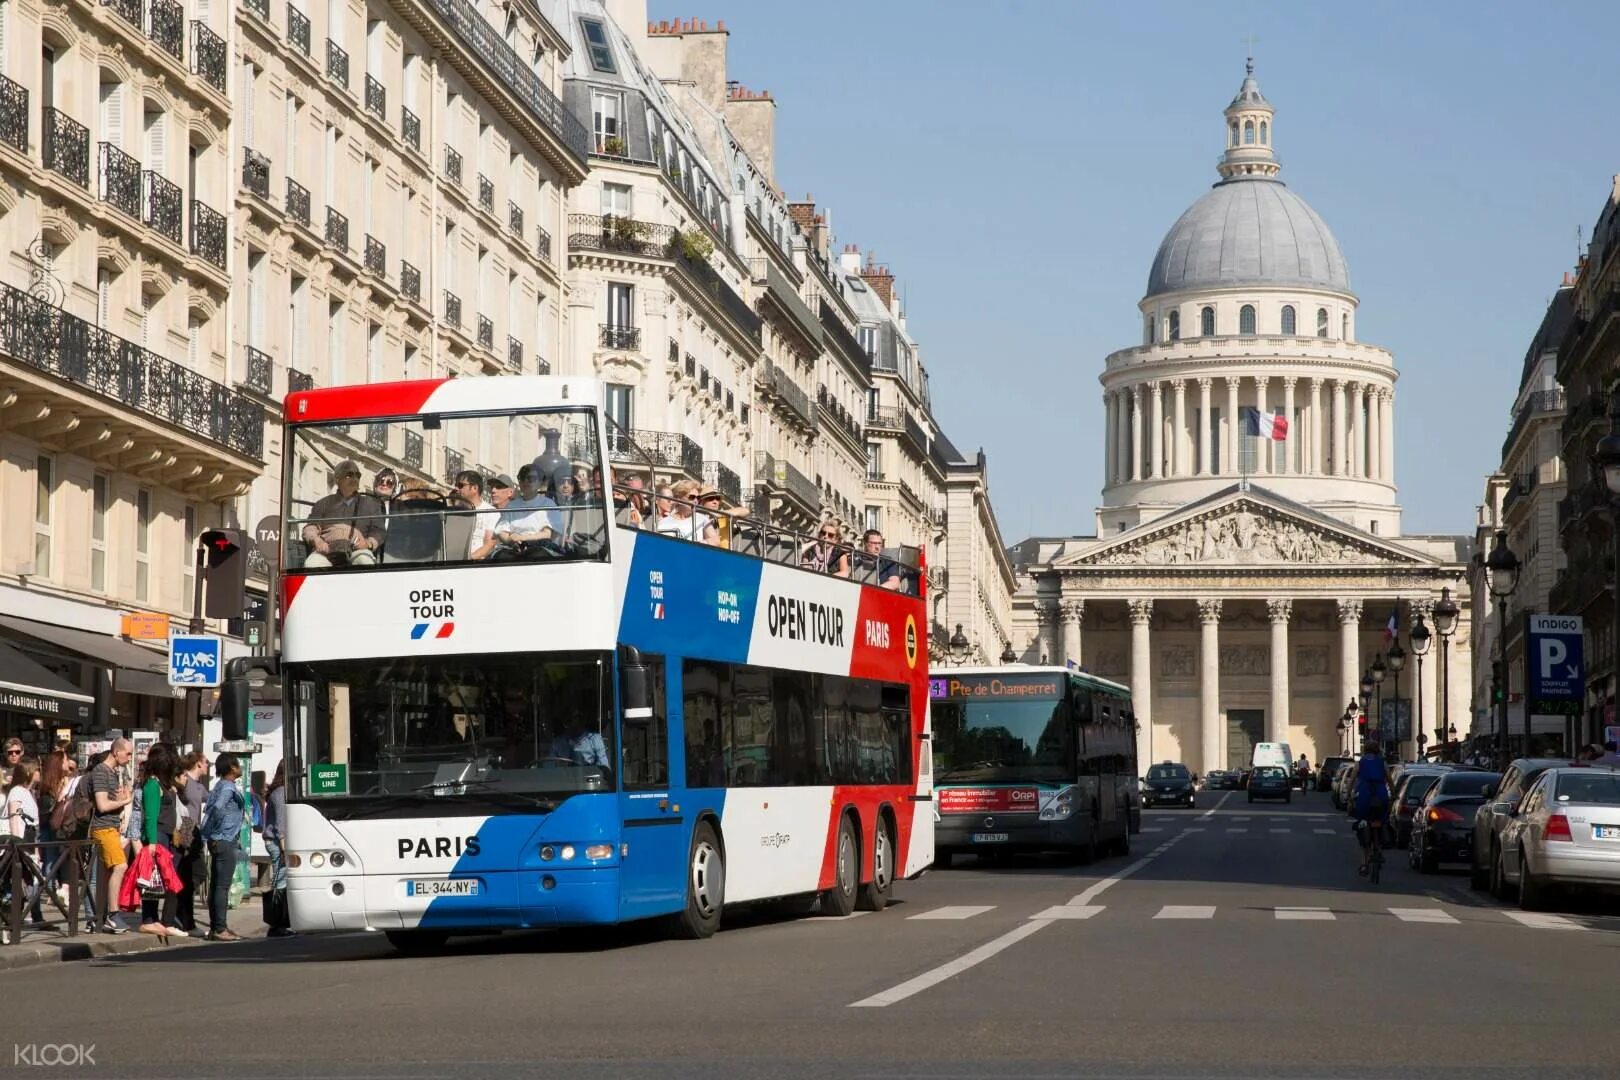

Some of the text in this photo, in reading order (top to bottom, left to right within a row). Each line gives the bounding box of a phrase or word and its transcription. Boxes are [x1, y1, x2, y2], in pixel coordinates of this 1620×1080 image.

[260, 529, 280, 541] TA
[650, 570, 663, 584] OPEN
[409, 588, 454, 603] OPEN
[650, 586, 664, 600] TOUR
[718, 591, 738, 607] HOP-ON
[409, 605, 455, 619] TOUR
[718, 607, 740, 624] HOP-OFF
[768, 594, 844, 647] OPEN TOUR
[1538, 620, 1577, 631] INDIGO
[865, 619, 890, 648] PARIS
[1540, 638, 1567, 678] P
[950, 680, 972, 696] Pte
[975, 684, 988, 695] de
[991, 679, 1057, 696] Champerret
[0, 693, 59, 713] LA FABRIQUE GIVRÉE
[321, 780, 337, 788] LINE
[398, 836, 481, 859] PARIS
